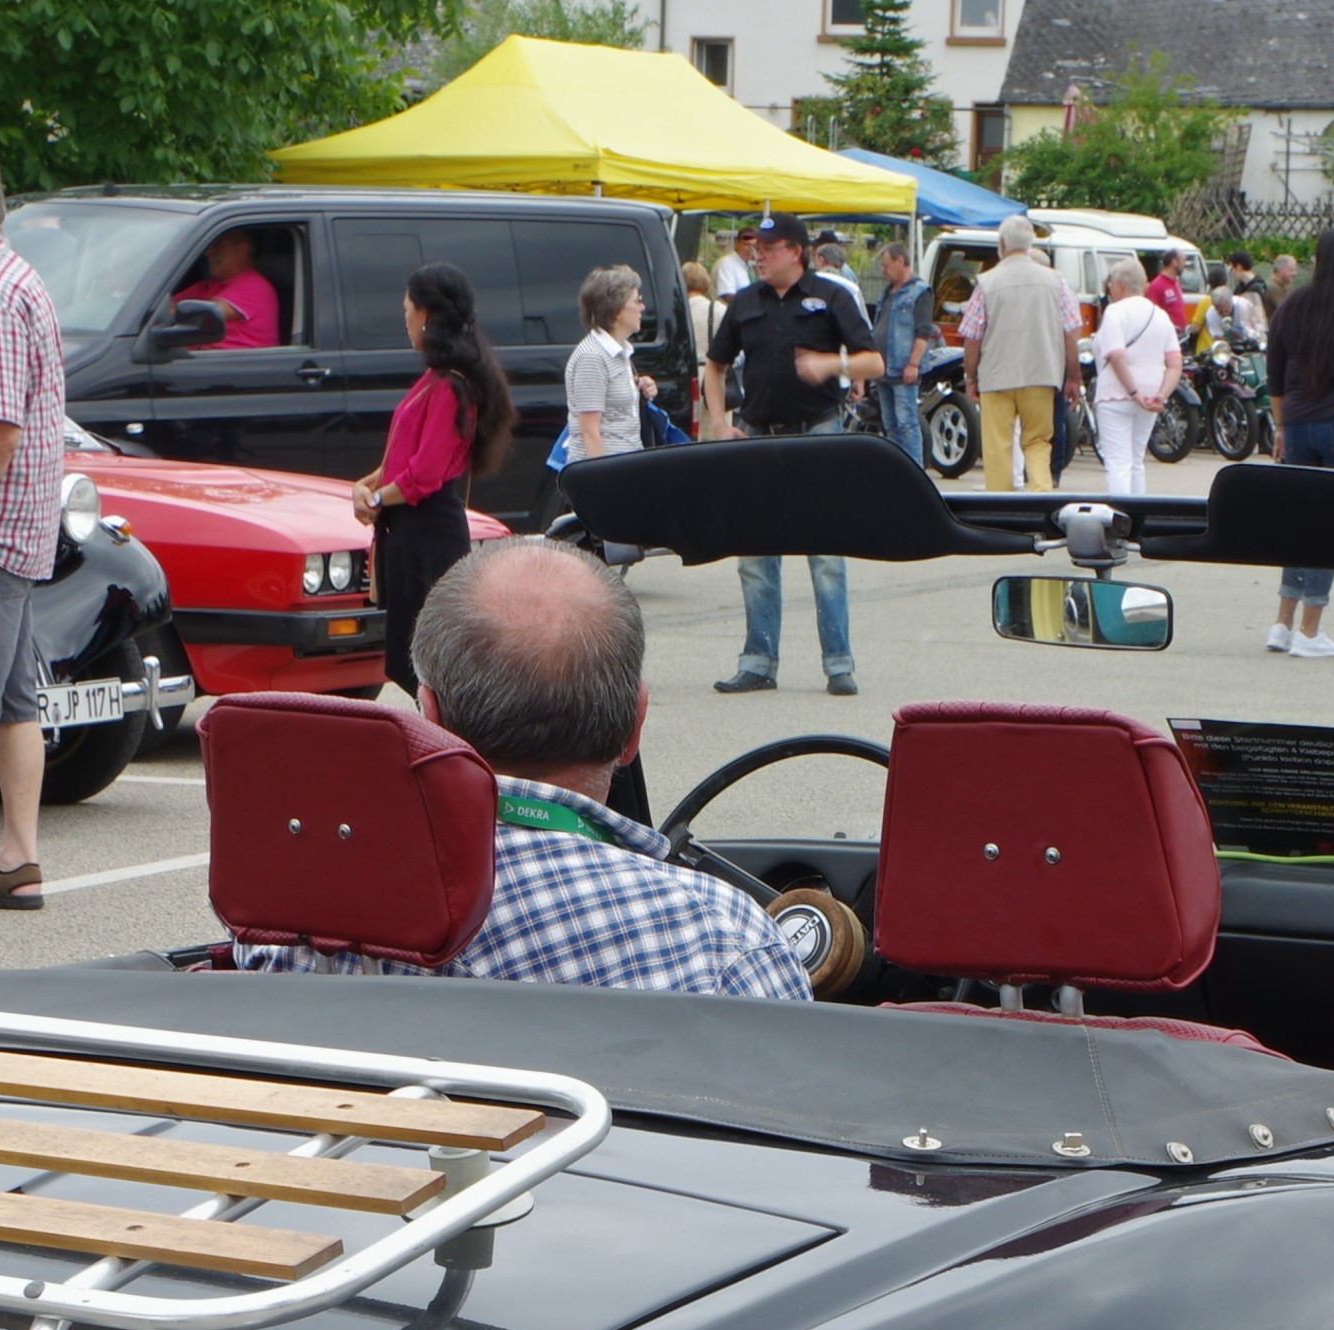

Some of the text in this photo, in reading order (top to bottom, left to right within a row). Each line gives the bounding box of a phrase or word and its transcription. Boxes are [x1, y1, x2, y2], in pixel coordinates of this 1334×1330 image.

[1181, 733, 1204, 742] Bitte
[1206, 734, 1231, 743] diese
[1233, 735, 1296, 745] Startnummer
